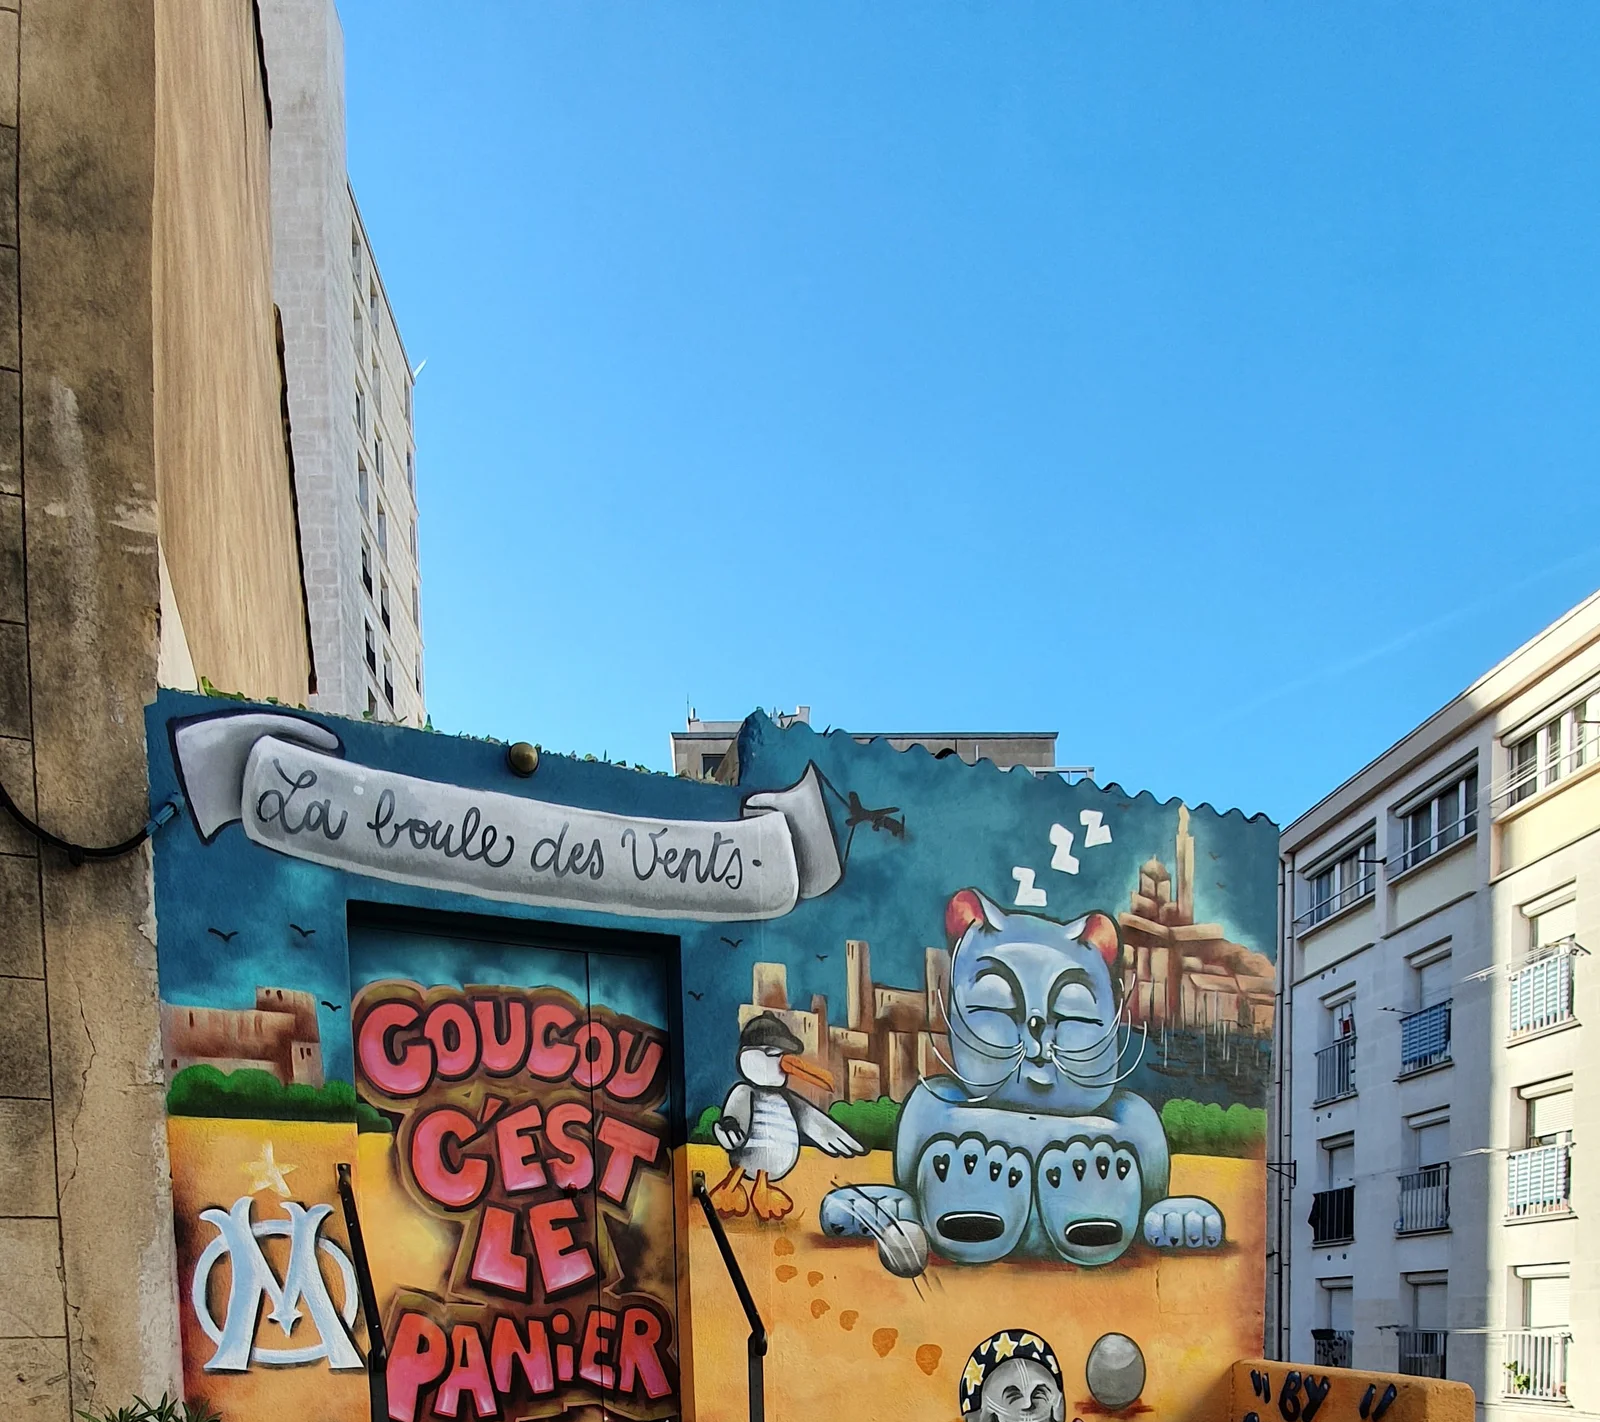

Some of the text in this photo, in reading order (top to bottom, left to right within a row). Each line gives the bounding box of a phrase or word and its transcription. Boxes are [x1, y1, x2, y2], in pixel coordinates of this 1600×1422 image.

[255, 757, 349, 841] La
[366, 789, 515, 868] boule
[531, 821, 606, 881] des
[357, 1000, 666, 1098] COUCOU
[409, 1098, 661, 1208] C'EST
[469, 1199, 597, 1295] LE
